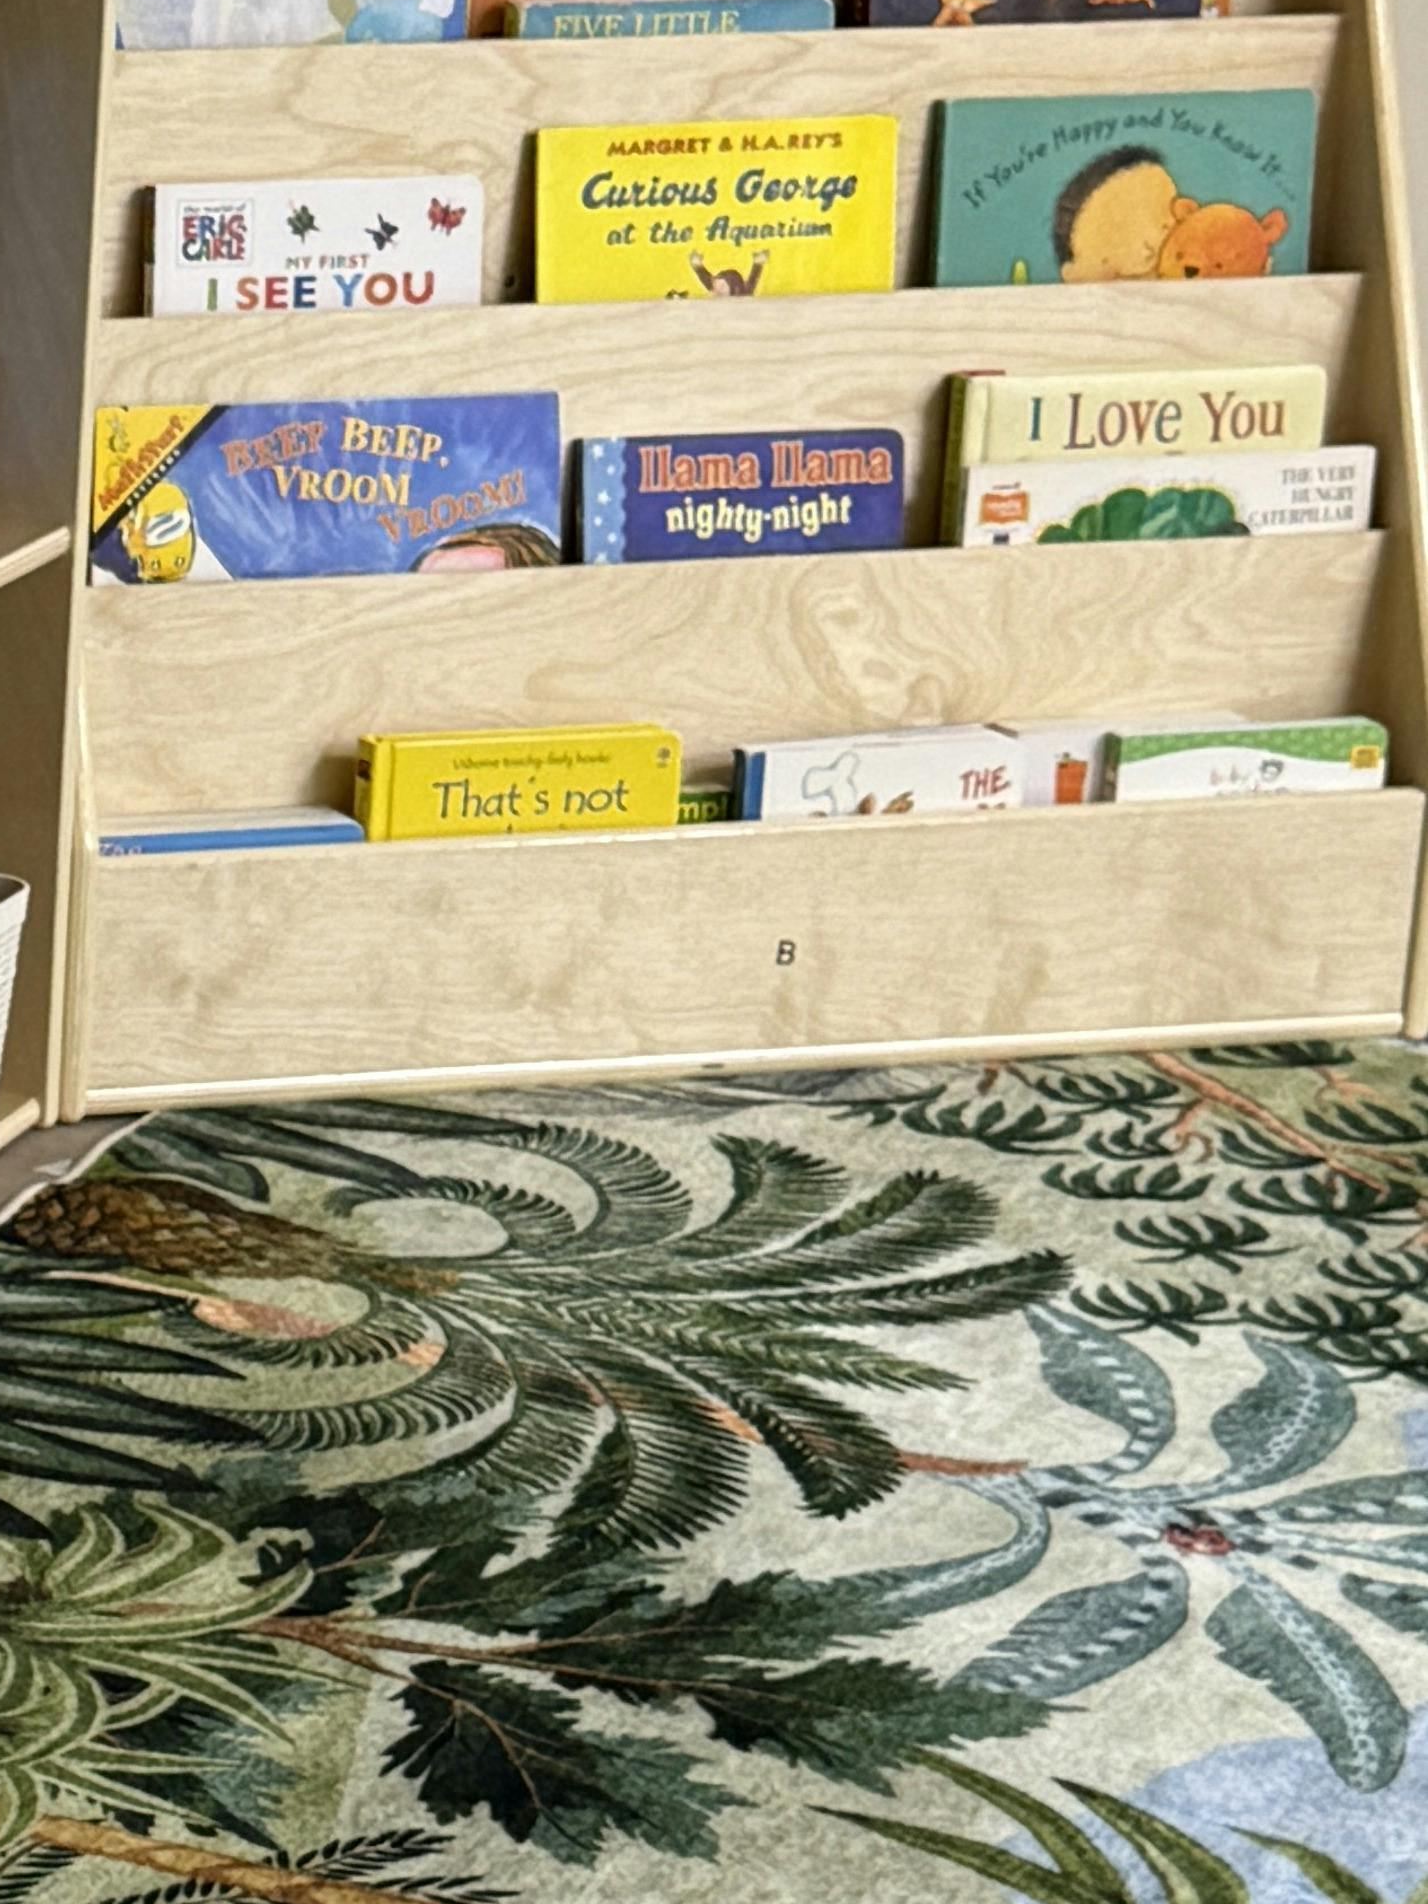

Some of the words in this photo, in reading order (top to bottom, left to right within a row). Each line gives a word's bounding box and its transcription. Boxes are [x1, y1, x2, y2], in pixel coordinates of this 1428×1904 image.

[554, 14, 624, 38] FIVE
[634, 10, 741, 36] LITTLE
[607, 137, 712, 157] MARGRET
[719, 134, 733, 152] &
[962, 181, 986, 210] If
[982, 142, 1049, 188] You're
[1051, 114, 1119, 152] Happy
[1123, 107, 1165, 130] and
[1170, 108, 1207, 136] You
[1209, 122, 1263, 164] Know
[581, 171, 718, 211] Curious
[734, 168, 859, 213] George
[182, 214, 247, 240] ERIC
[606, 221, 636, 246] at
[649, 219, 694, 245] the
[705, 215, 833, 247] Aquarium
[182, 238, 245, 261] CARLE
[286, 255, 312, 270] MY
[319, 253, 370, 269] FIRST
[207, 278, 218, 311] I
[236, 276, 317, 311] SEE
[332, 270, 435, 308] YOU
[1028, 397, 1043, 442] I
[1064, 393, 1182, 450] Love
[1199, 391, 1286, 443] You
[220, 420, 328, 477] BEEP
[342, 416, 450, 469] BEEP,
[639, 445, 762, 493] llama
[770, 441, 894, 488] llama
[272, 464, 414, 507] VROOM
[376, 469, 528, 544] VROOM!
[432, 776, 550, 819] That's
[563, 778, 630, 815] not
[959, 765, 1012, 800] THE
[775, 939, 797, 966] B
